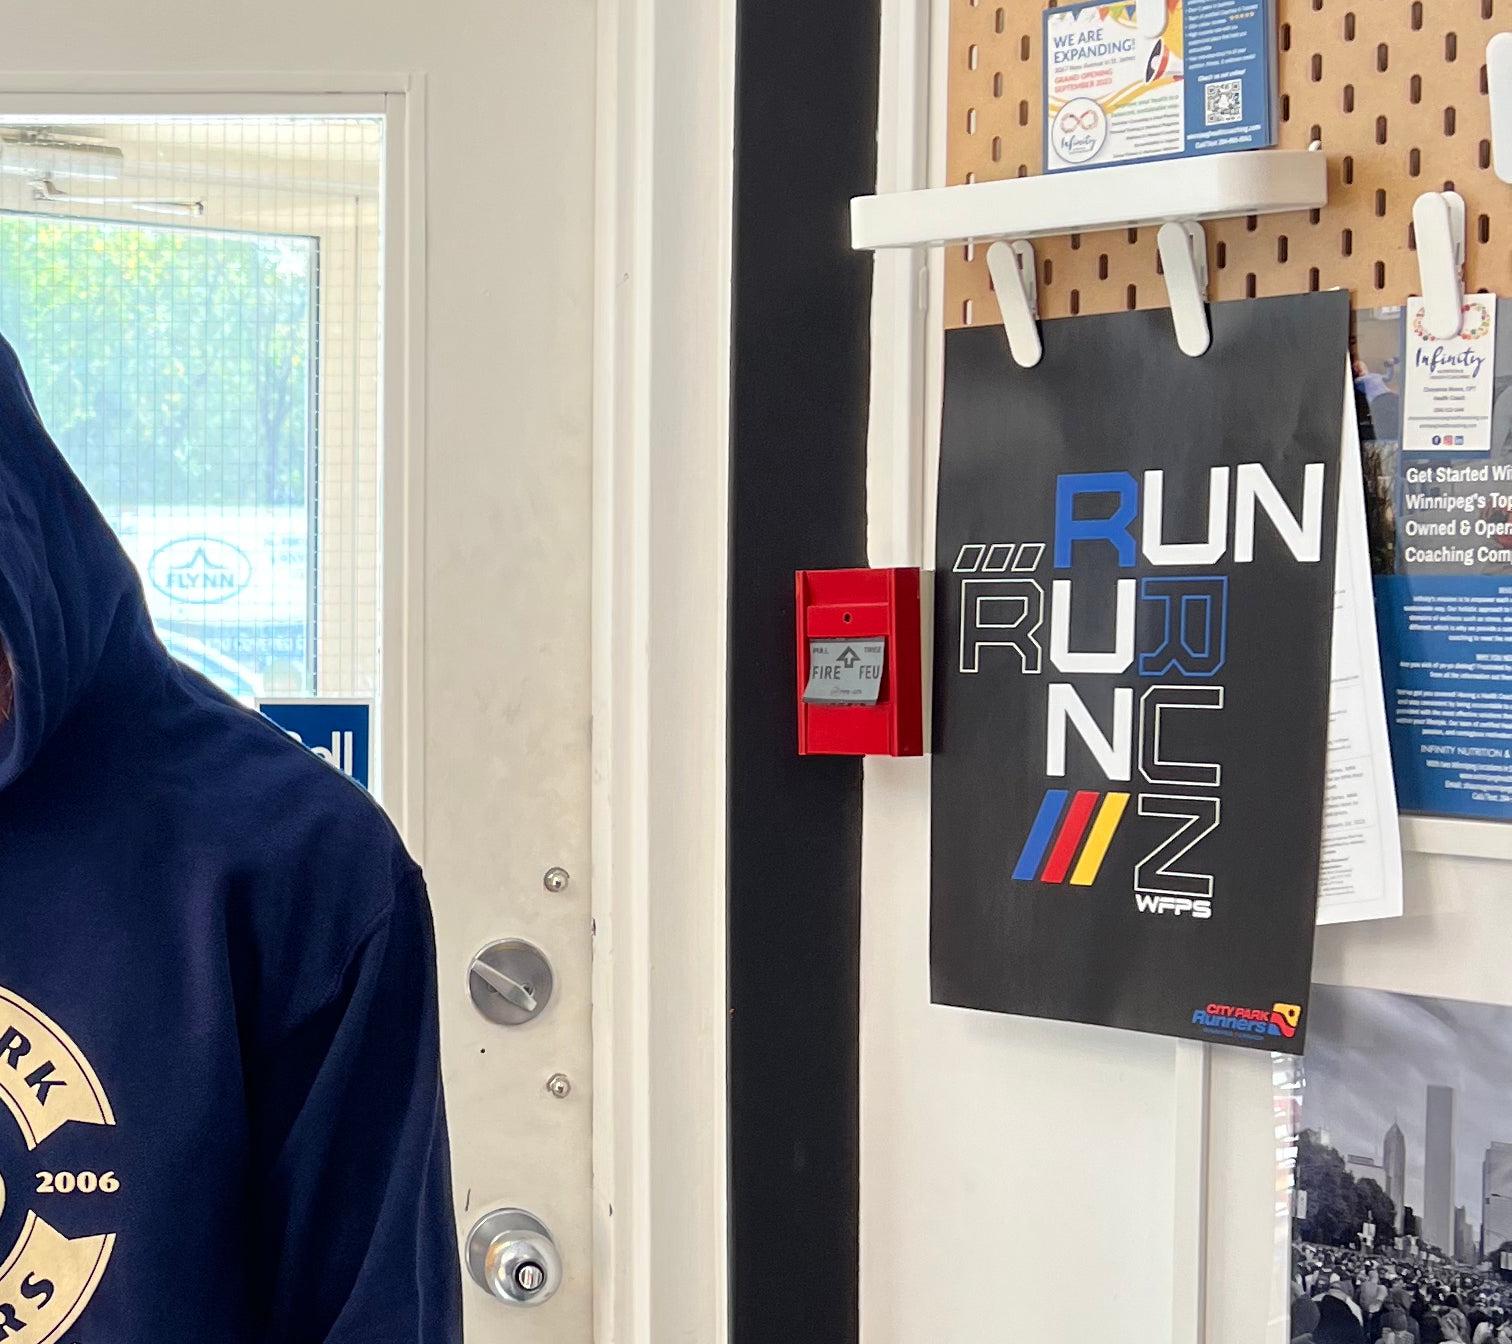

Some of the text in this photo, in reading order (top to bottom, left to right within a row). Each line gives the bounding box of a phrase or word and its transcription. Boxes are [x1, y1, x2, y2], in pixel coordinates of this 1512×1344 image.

[1053, 28, 1103, 49] WE ARE
[1054, 38, 1136, 64] EXPANDING!
[1416, 346, 1486, 378] Infinity
[1406, 465, 1512, 483] Get Started Wi
[1405, 493, 1486, 512] Winnipeg's
[1053, 462, 1325, 568] RUN
[1405, 519, 1512, 538] Owned & Oper
[1405, 546, 1512, 565] Coaching Com
[166, 571, 236, 588] FLYNN
[812, 665, 841, 680] FIRE
[859, 665, 880, 680] FEU
[1134, 894, 1212, 919] WFPS
[1192, 1010, 1266, 1034] Runners
[1207, 1003, 1270, 1022] CITY PARK
[35, 1170, 120, 1194] 2006
